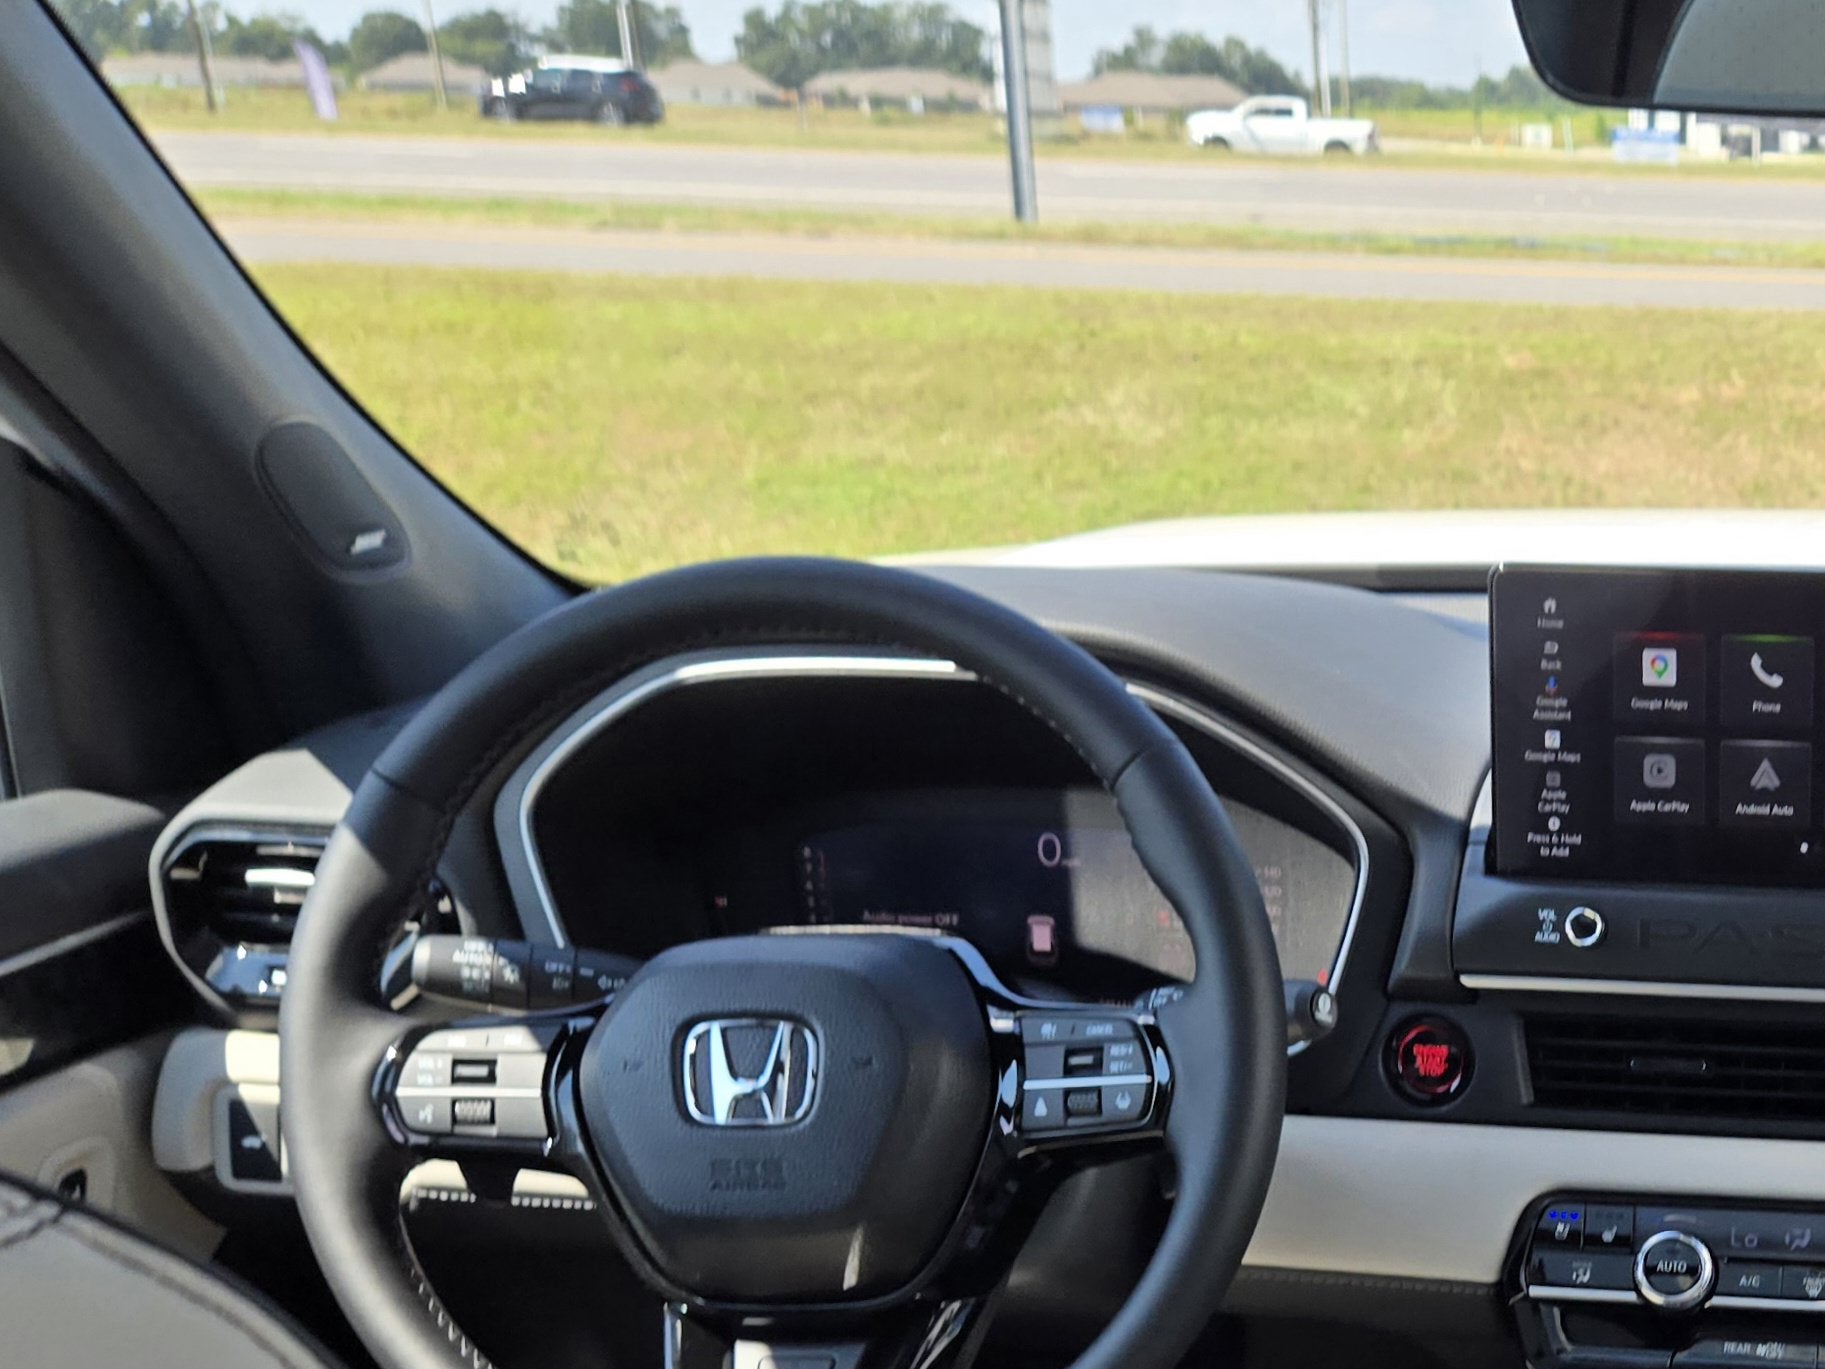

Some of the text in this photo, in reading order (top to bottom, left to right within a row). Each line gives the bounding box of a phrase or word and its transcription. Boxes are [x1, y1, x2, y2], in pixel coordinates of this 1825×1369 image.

[1537, 616, 1564, 629] Home
[1540, 657, 1562, 671] Back
[1536, 694, 1569, 708] Google
[1631, 697, 1688, 711] Google Maps
[1752, 700, 1781, 714] Phone
[1524, 749, 1581, 764] Google Maps
[1541, 788, 1567, 801] Apple
[1630, 799, 1690, 815] Apple CarPlay
[1735, 801, 1794, 817] Android Auto
[1731, 1227, 1758, 1248] Lo
[1656, 1260, 1687, 1273] AUTO
[1738, 1274, 1761, 1288] A/C
[1723, 1341, 1751, 1355] REAR
